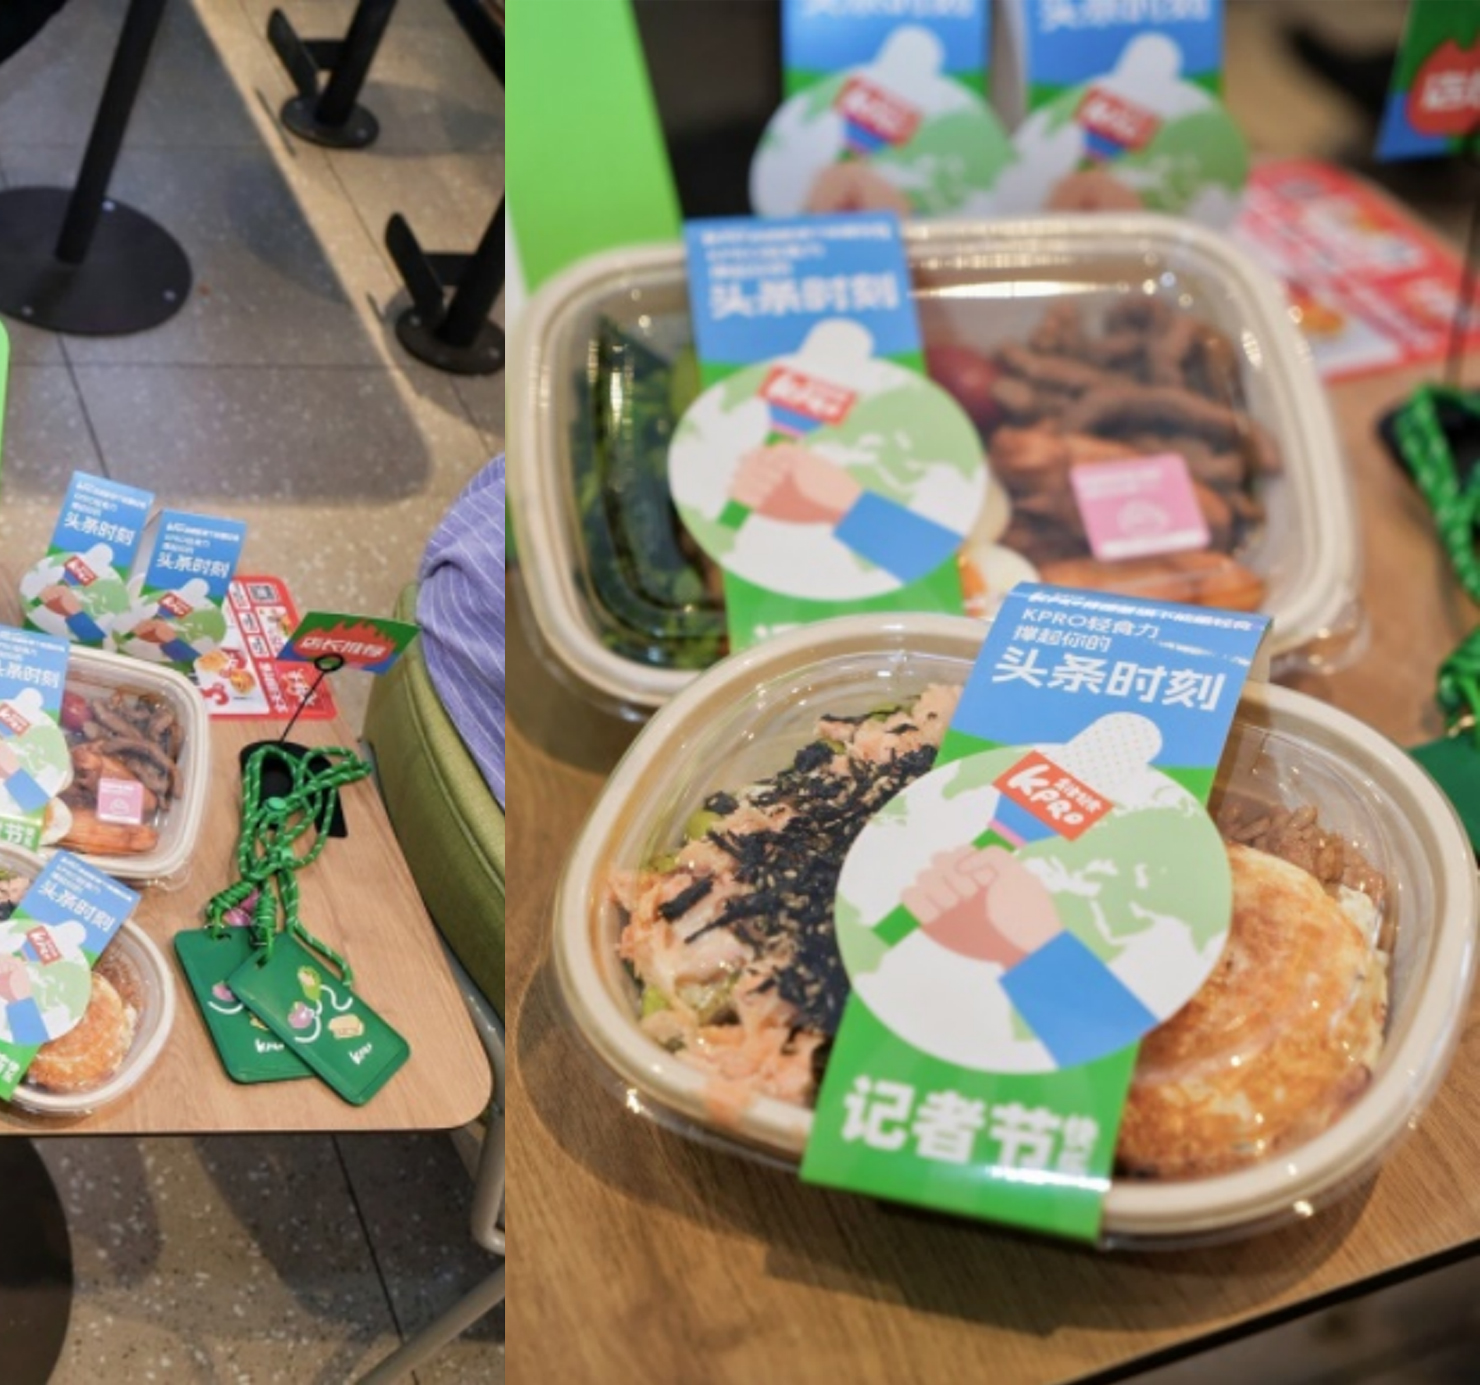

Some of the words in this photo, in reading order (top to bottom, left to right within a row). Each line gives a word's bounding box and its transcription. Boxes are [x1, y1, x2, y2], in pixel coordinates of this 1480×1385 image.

[1013, 624, 1112, 653] 撑起你的
[1022, 607, 1160, 639] KPRO轻食力
[992, 645, 1226, 712] 头条时刻
[1006, 763, 1085, 825] KPRO
